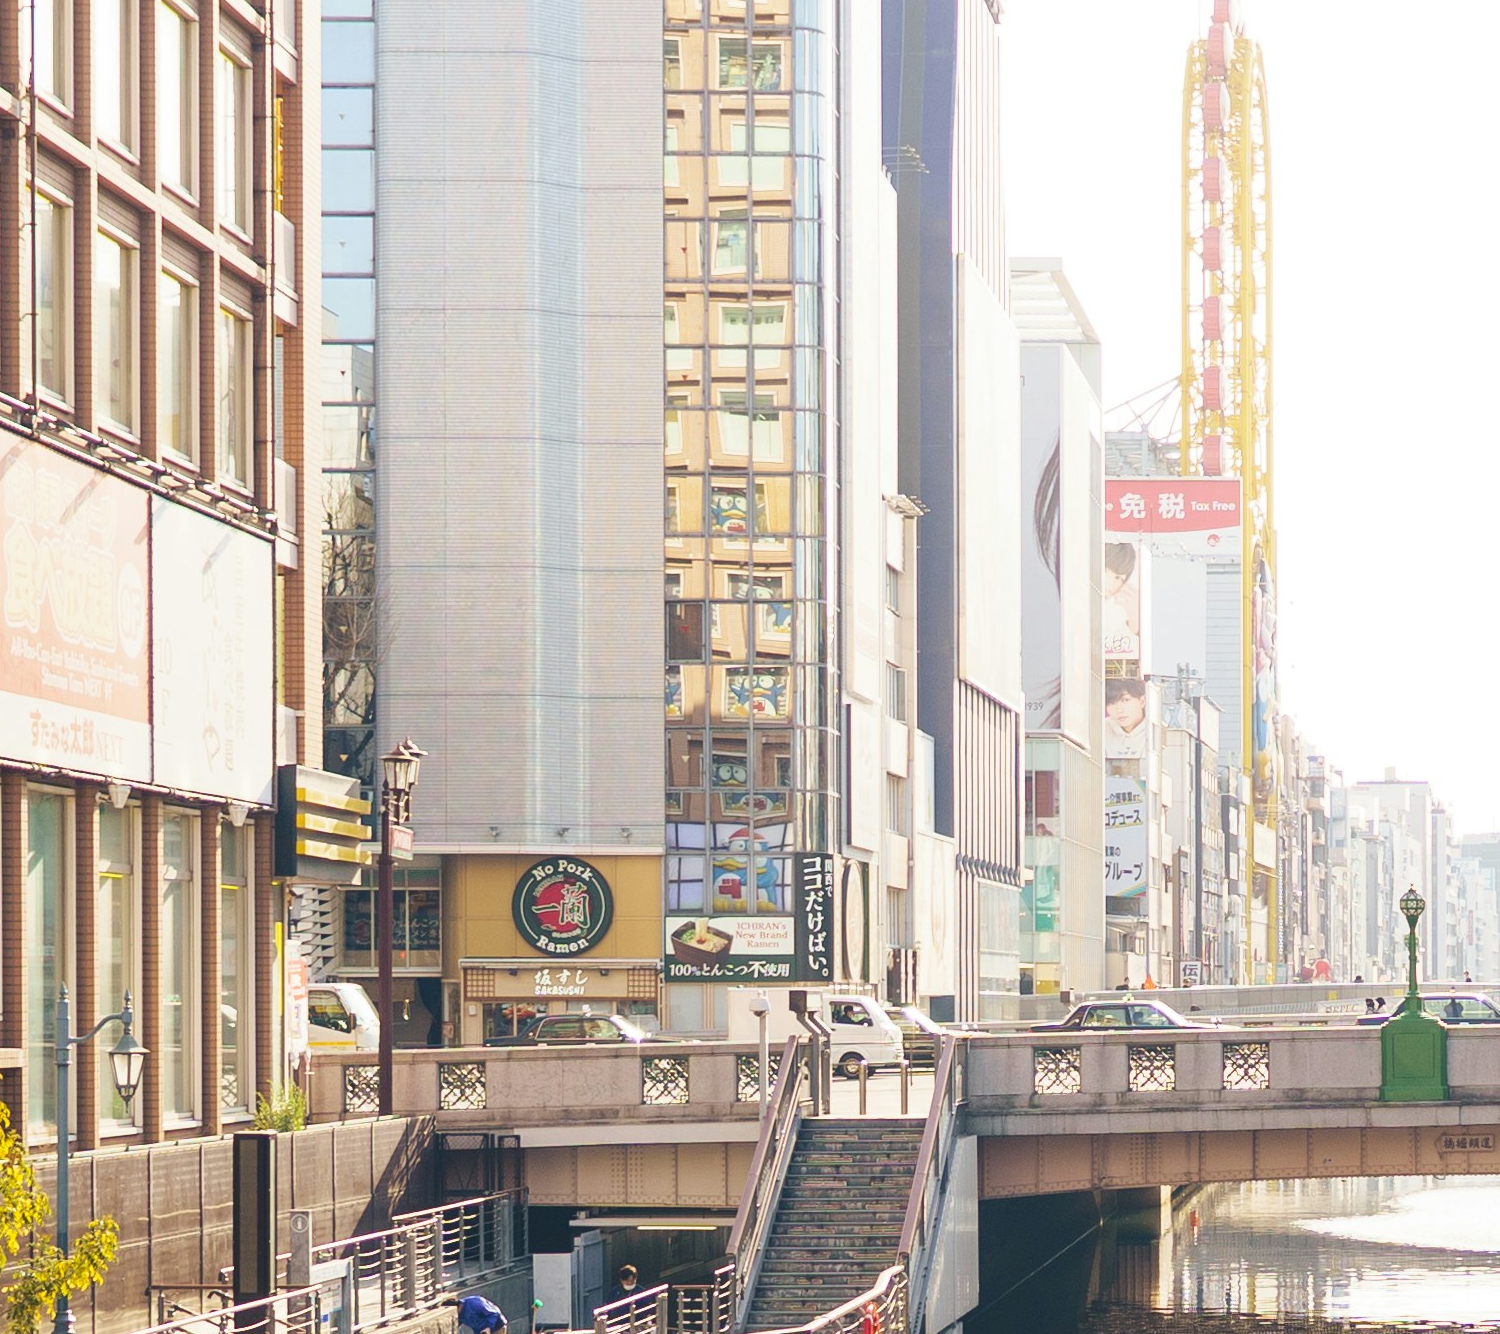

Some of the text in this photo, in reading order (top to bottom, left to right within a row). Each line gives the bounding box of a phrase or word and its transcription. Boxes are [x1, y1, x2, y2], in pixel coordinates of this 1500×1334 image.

[1119, 493, 1186, 519] 免税
[1191, 501, 1236, 511] Tax Free
[531, 859, 594, 882] No Pork
[531, 882, 591, 929] 一蘭
[535, 935, 589, 953] Ramen
[735, 931, 788, 940] New Brand
[747, 940, 780, 949] Ramen
